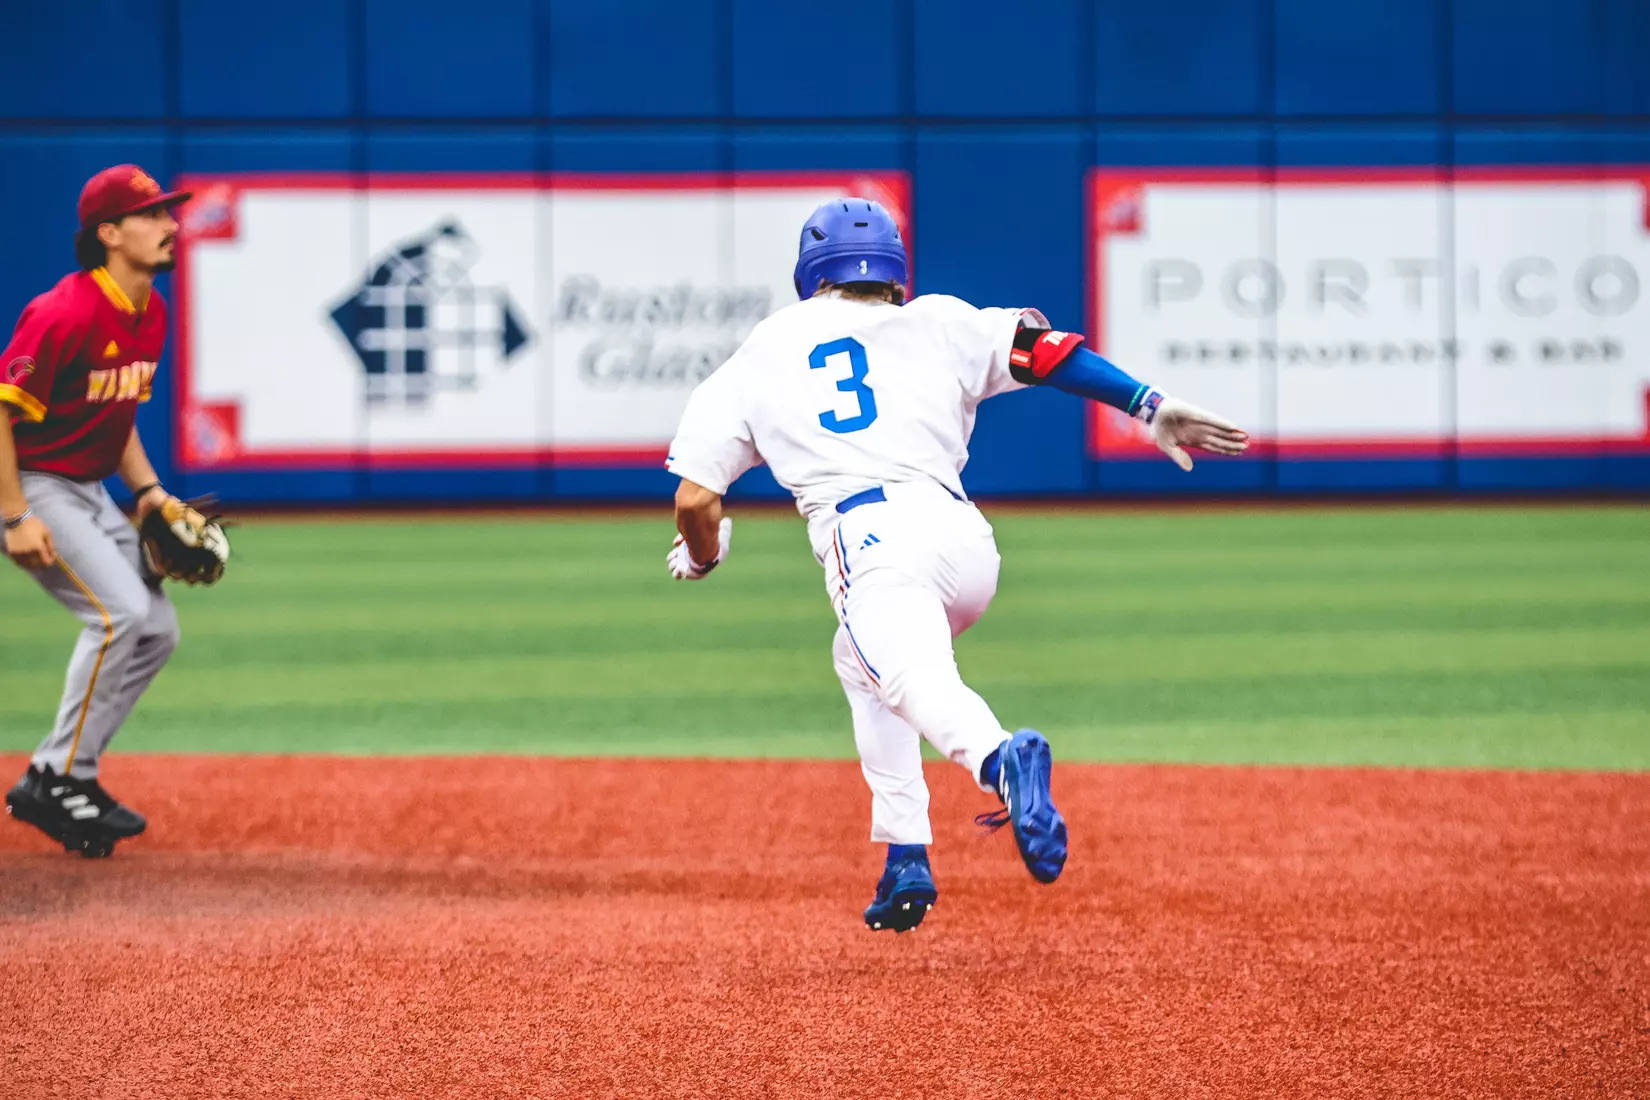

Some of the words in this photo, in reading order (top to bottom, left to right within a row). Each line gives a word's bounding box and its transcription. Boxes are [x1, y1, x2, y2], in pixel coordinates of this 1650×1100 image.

[1141, 256, 1641, 318] PORTICO
[1160, 338, 1458, 367] RESTAURANT
[1532, 337, 1625, 366] BAR
[808, 336, 878, 433] 3
